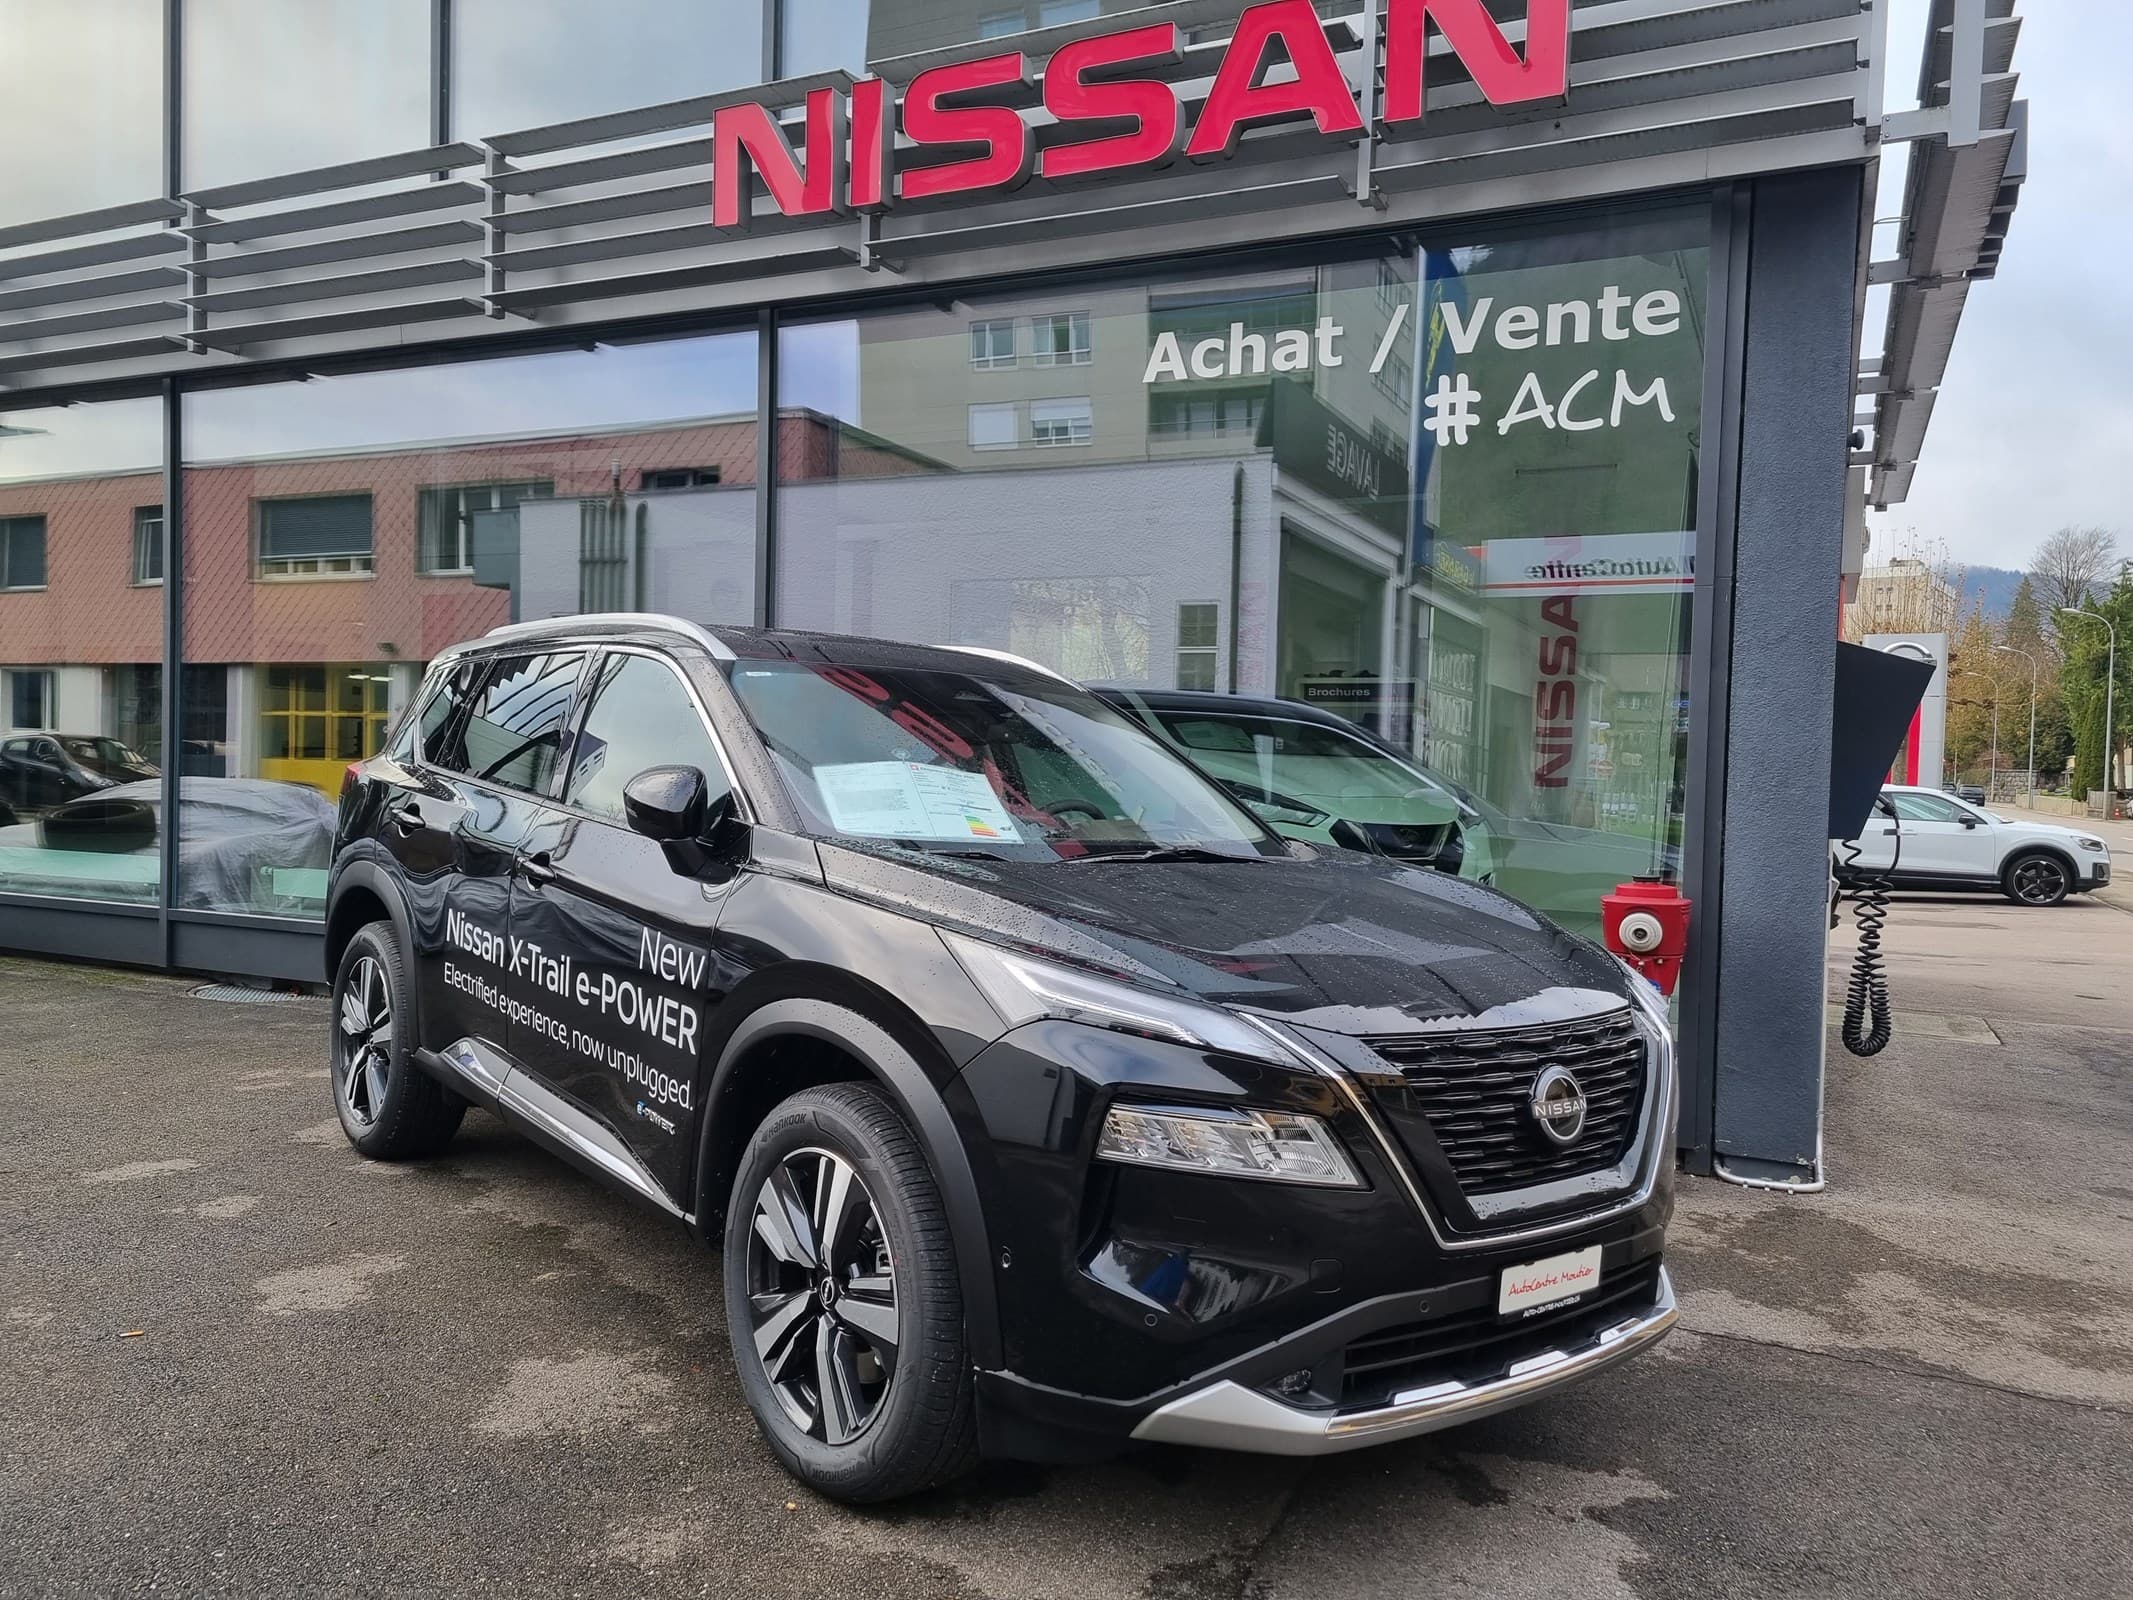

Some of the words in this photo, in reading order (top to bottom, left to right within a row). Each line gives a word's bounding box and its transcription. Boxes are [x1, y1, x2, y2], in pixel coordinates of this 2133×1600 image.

[712, 0, 1569, 228] NISSAN
[1143, 316, 1344, 383] Achat
[1369, 304, 1409, 374] /
[1440, 285, 1681, 354] Vente
[1423, 374, 1481, 446] #
[1498, 369, 1675, 435] ACM
[1308, 687, 1371, 697] Brochures
[1534, 535, 1582, 788] NISSAN
[446, 908, 505, 968] Nissan
[509, 935, 571, 998] X-Trail
[576, 971, 698, 1055] e-POWER
[639, 927, 705, 989] New
[444, 962, 498, 1009] Electrified
[499, 994, 570, 1050] experience,
[572, 1026, 606, 1062] now
[607, 1045, 694, 1111] unplugged.
[1535, 1097, 1587, 1119] NISSAN
[1508, 1274, 1559, 1297] AutoCentre
[1560, 1264, 1594, 1285] Moutier
